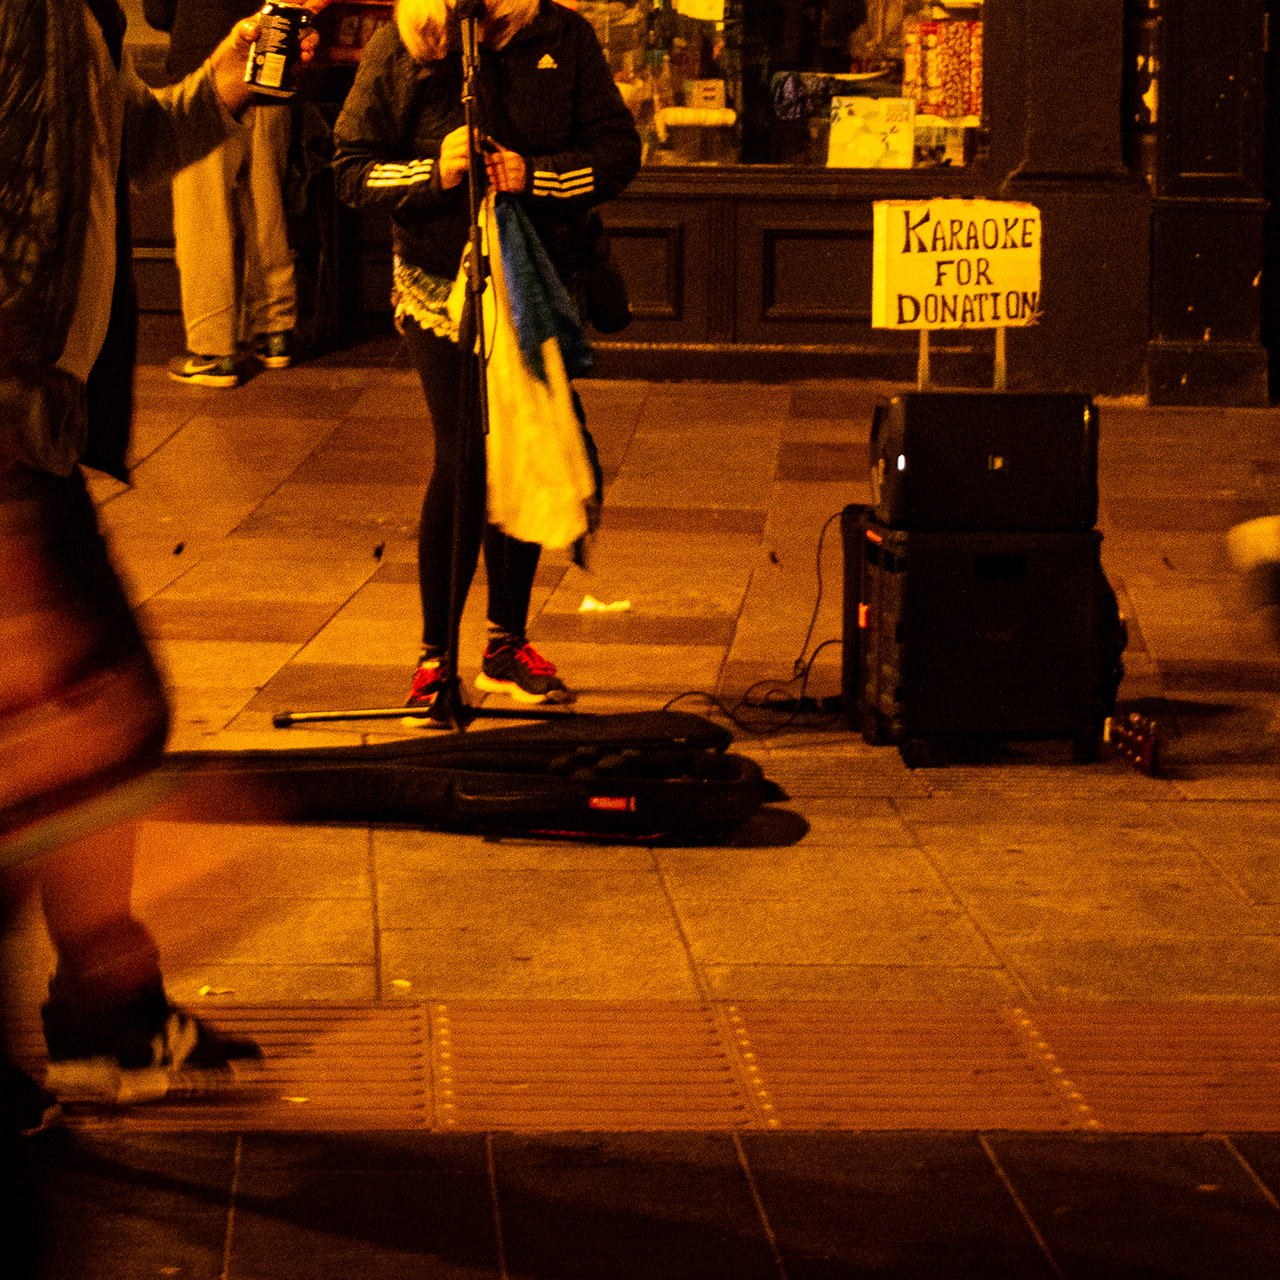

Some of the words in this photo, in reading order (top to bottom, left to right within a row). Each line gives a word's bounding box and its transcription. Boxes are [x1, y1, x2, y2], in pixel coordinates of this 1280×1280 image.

[901, 208, 1036, 254] KARAOKE
[934, 257, 994, 287] FOR
[896, 290, 1043, 325] DONATION
